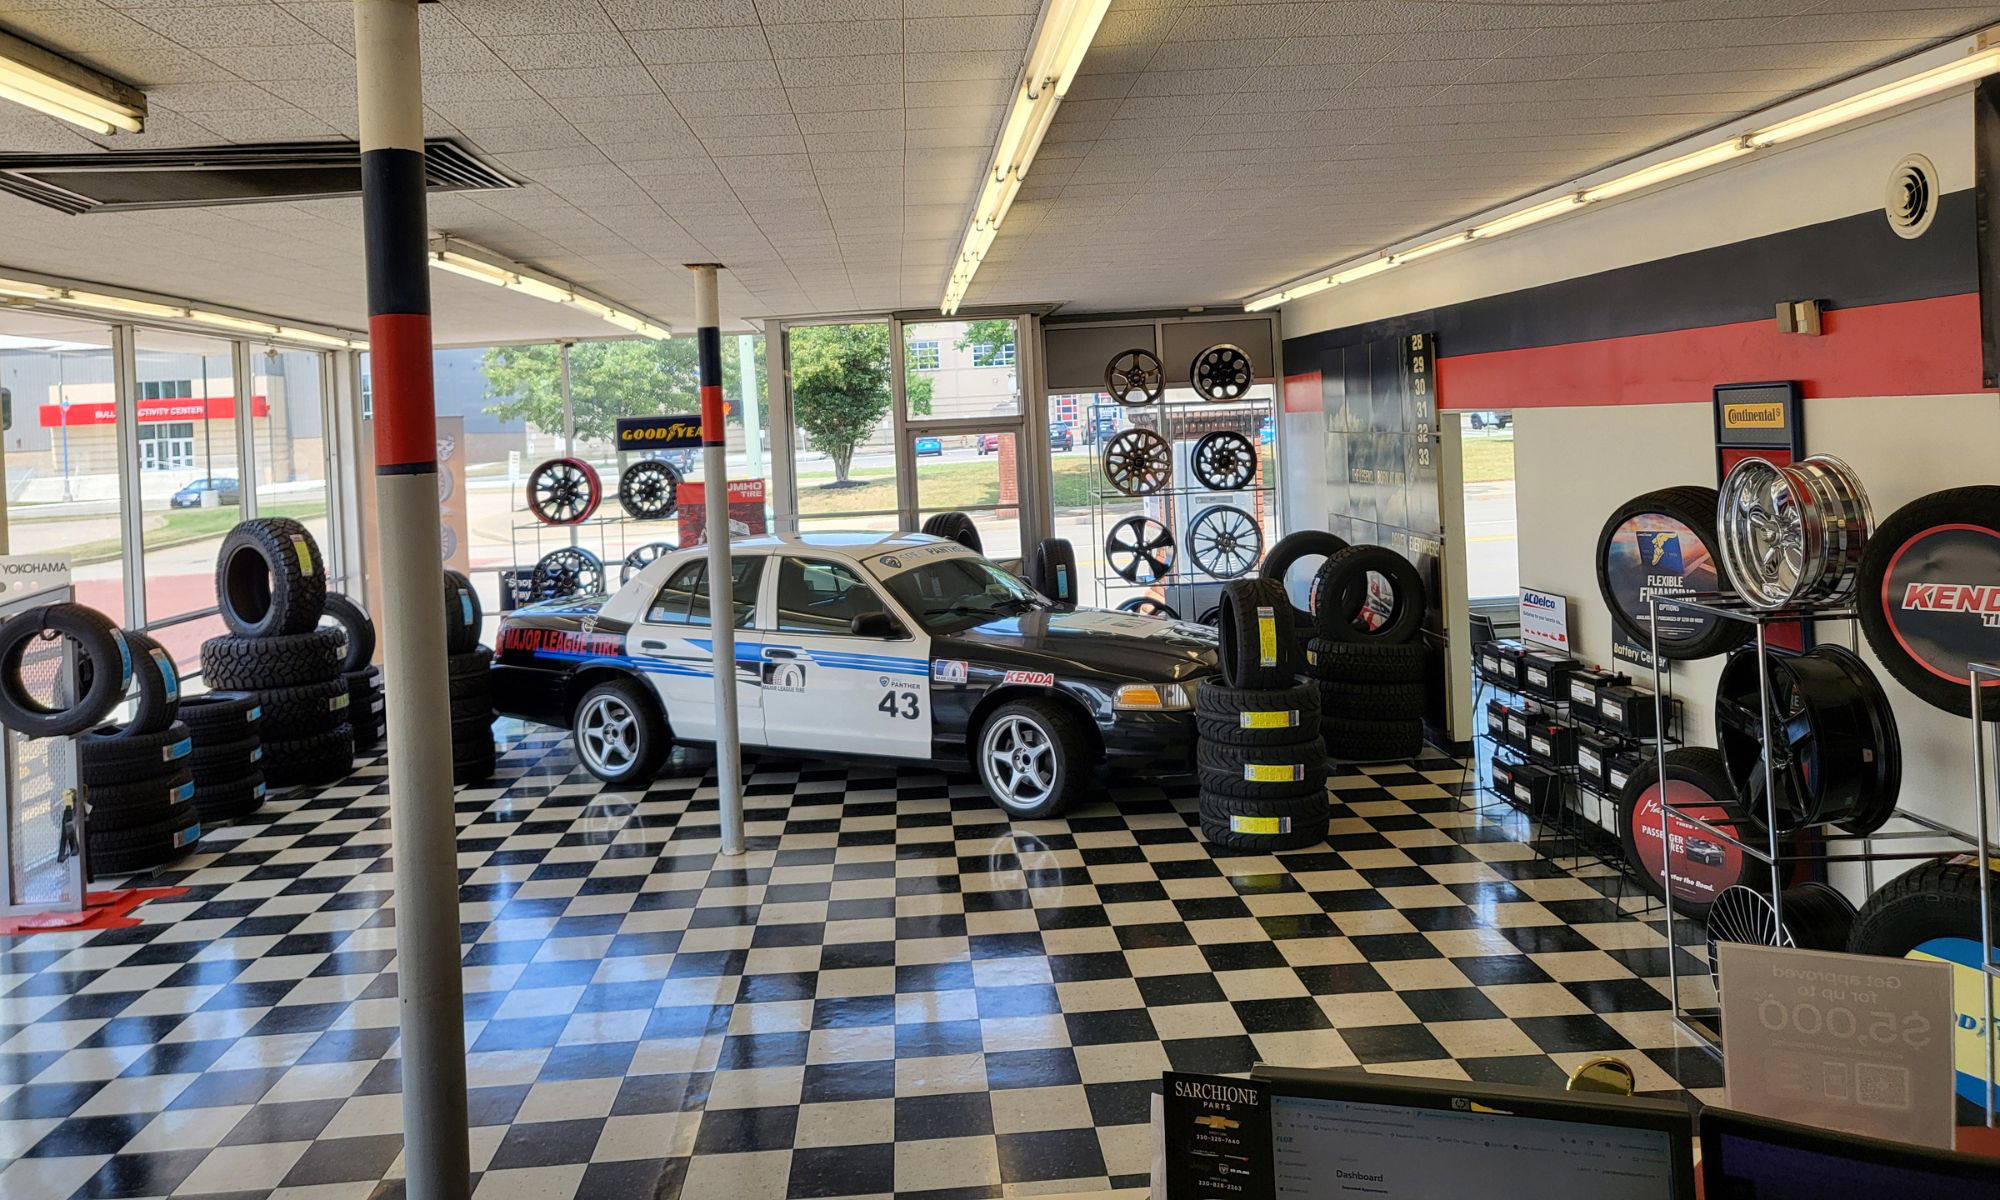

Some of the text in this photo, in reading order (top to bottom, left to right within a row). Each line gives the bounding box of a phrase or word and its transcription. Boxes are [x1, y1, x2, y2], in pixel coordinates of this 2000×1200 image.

[1411, 334, 1423, 351] 28
[1413, 356, 1425, 373] 29
[1415, 378, 1426, 395] 30
[138, 408, 169, 417] CTIVITY
[1416, 401, 1428, 418] 31
[1728, 408, 1776, 424] Continental
[622, 424, 703, 441] GOODYEA
[1417, 423, 1429, 443] 32
[1419, 448, 1430, 466] 33
[728, 482, 763, 491] UMHO
[2, 563, 68, 574] YOKOHAMA
[1647, 575, 1684, 587] FLEXIBLE
[1524, 592, 1556, 609] ACDelco
[1902, 583, 2000, 613] KEND
[505, 627, 541, 651] MAJOR
[543, 631, 588, 655] LEAGUE
[591, 639, 620, 657] TIRE
[1614, 642, 1666, 667] Battery Cener
[891, 682, 921, 690] PANTHER
[1004, 671, 1054, 686] KENDA
[879, 690, 920, 720] 43
[1642, 825, 1684, 845] PASSEGER
[1683, 877, 1695, 885] the
[1175, 1081, 1259, 1106] SARCHIONE
[1203, 1101, 1231, 1111] PARTS
[1336, 1169, 1384, 1182] Dashboard
